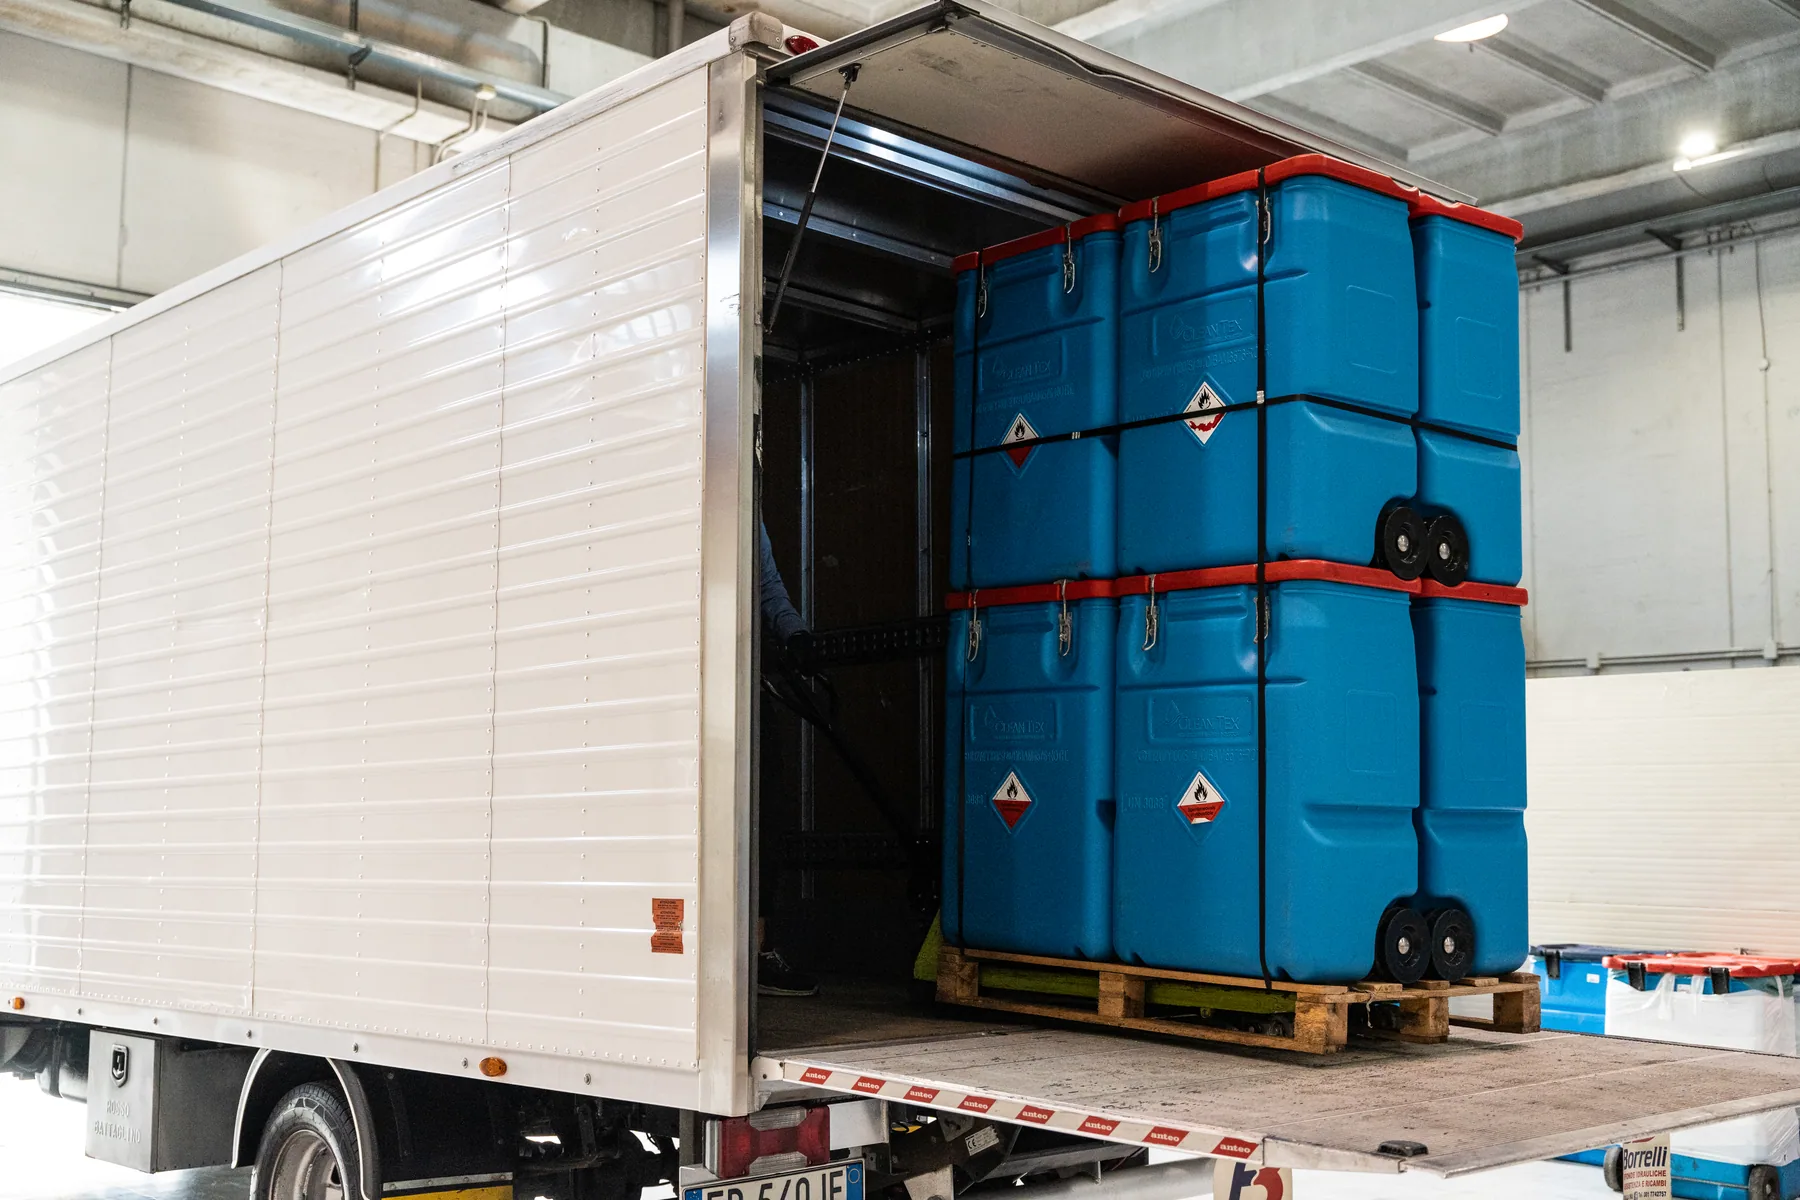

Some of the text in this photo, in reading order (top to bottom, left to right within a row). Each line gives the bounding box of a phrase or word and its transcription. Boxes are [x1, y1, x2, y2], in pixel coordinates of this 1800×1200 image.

[805, 1072, 827, 1080] anteo
[857, 1081, 880, 1090] anteo
[909, 1090, 933, 1099] anteo
[107, 1100, 129, 1118] ROSSO
[963, 1100, 989, 1110] anteo
[1022, 1110, 1048, 1120] anteo
[1084, 1121, 1113, 1131] anteo
[1150, 1132, 1180, 1142] anteo
[1219, 1144, 1251, 1154] anteo
[1624, 1146, 1667, 1170] Borrelli
